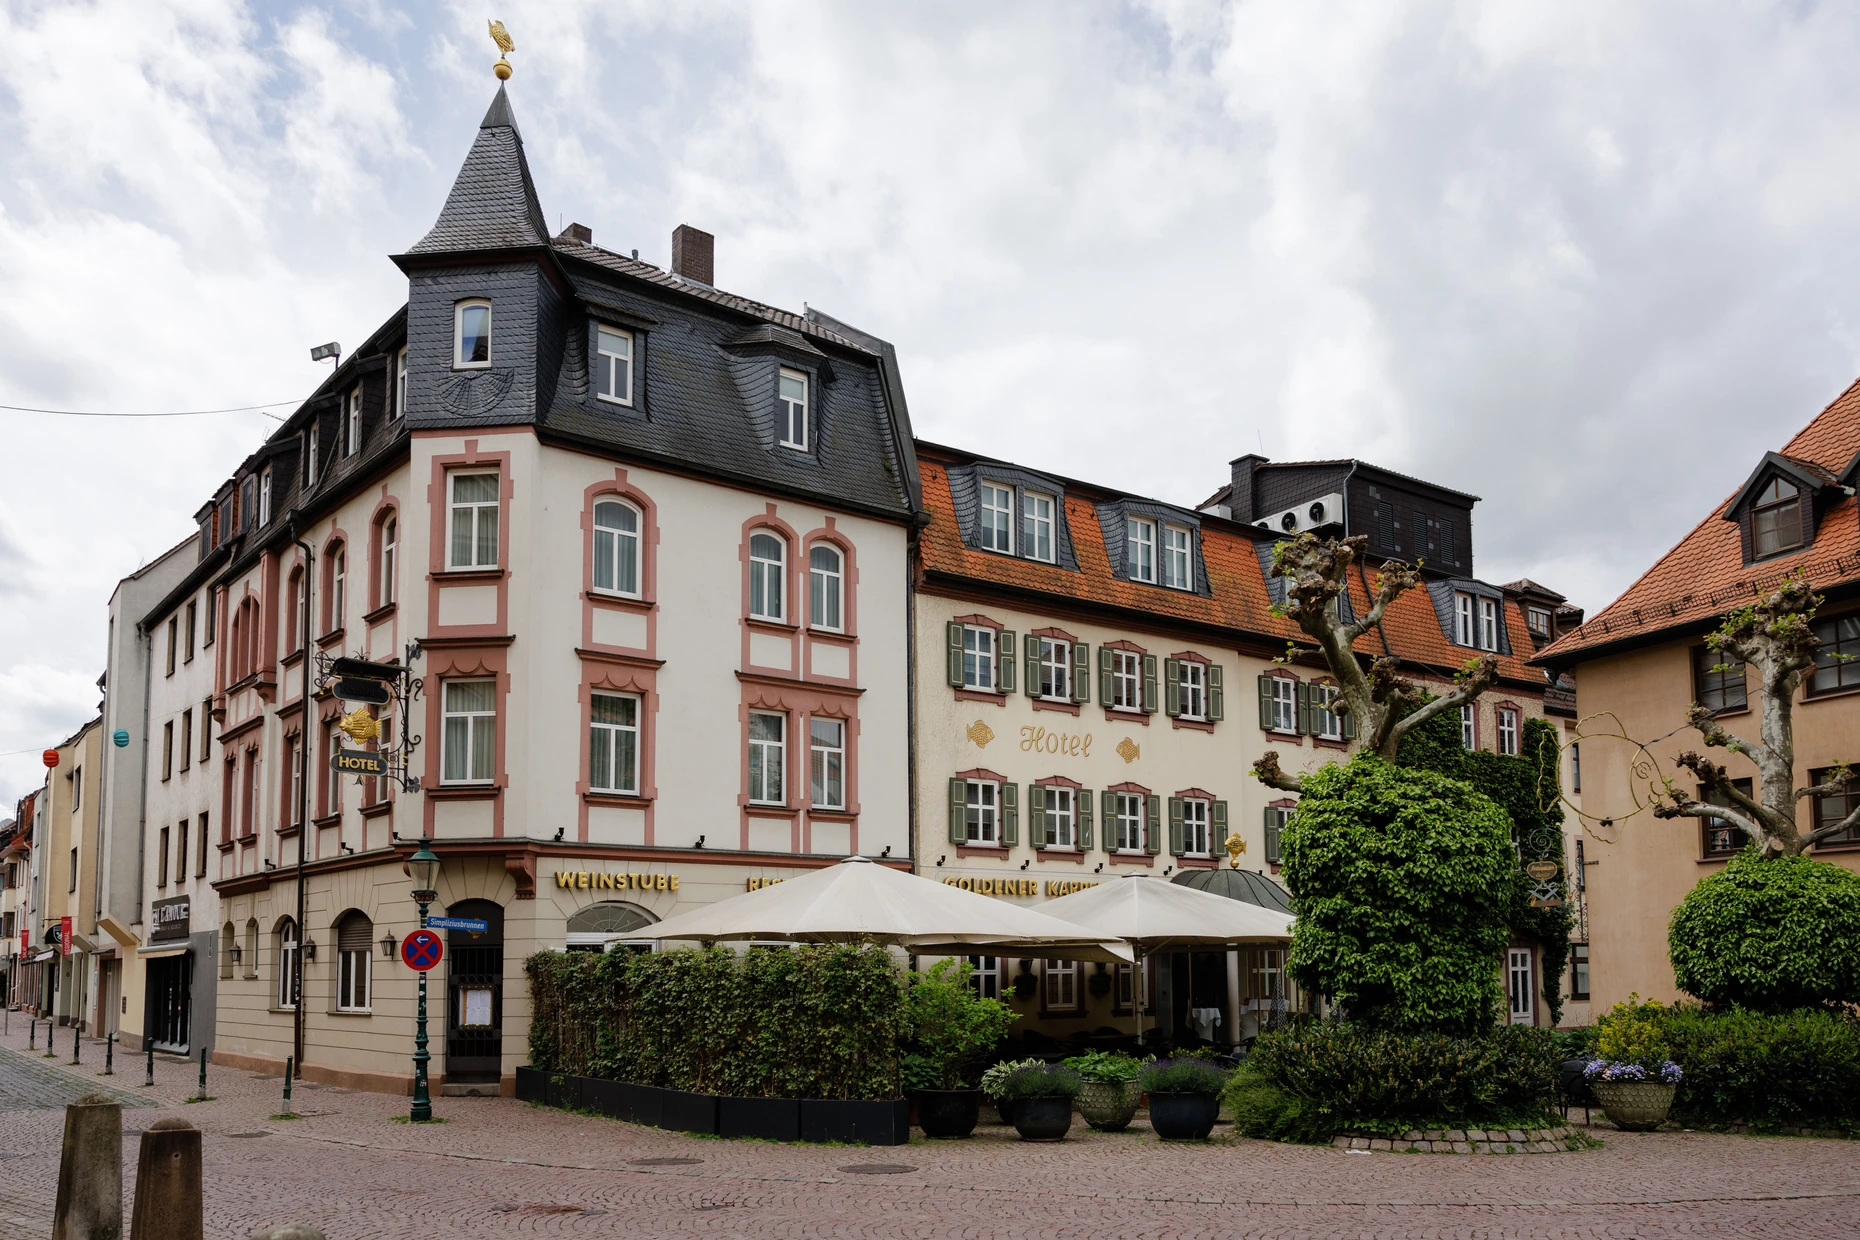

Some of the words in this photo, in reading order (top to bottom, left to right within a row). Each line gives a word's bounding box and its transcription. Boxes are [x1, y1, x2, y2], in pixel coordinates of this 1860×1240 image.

[1019, 725, 1093, 757] Hotel
[338, 756, 381, 772] HOTEL
[555, 871, 680, 891] WEINSTUBE
[748, 877, 788, 892] RE
[944, 877, 1038, 896] GOLDENER
[430, 918, 485, 929] Simpliziusbrunnen
